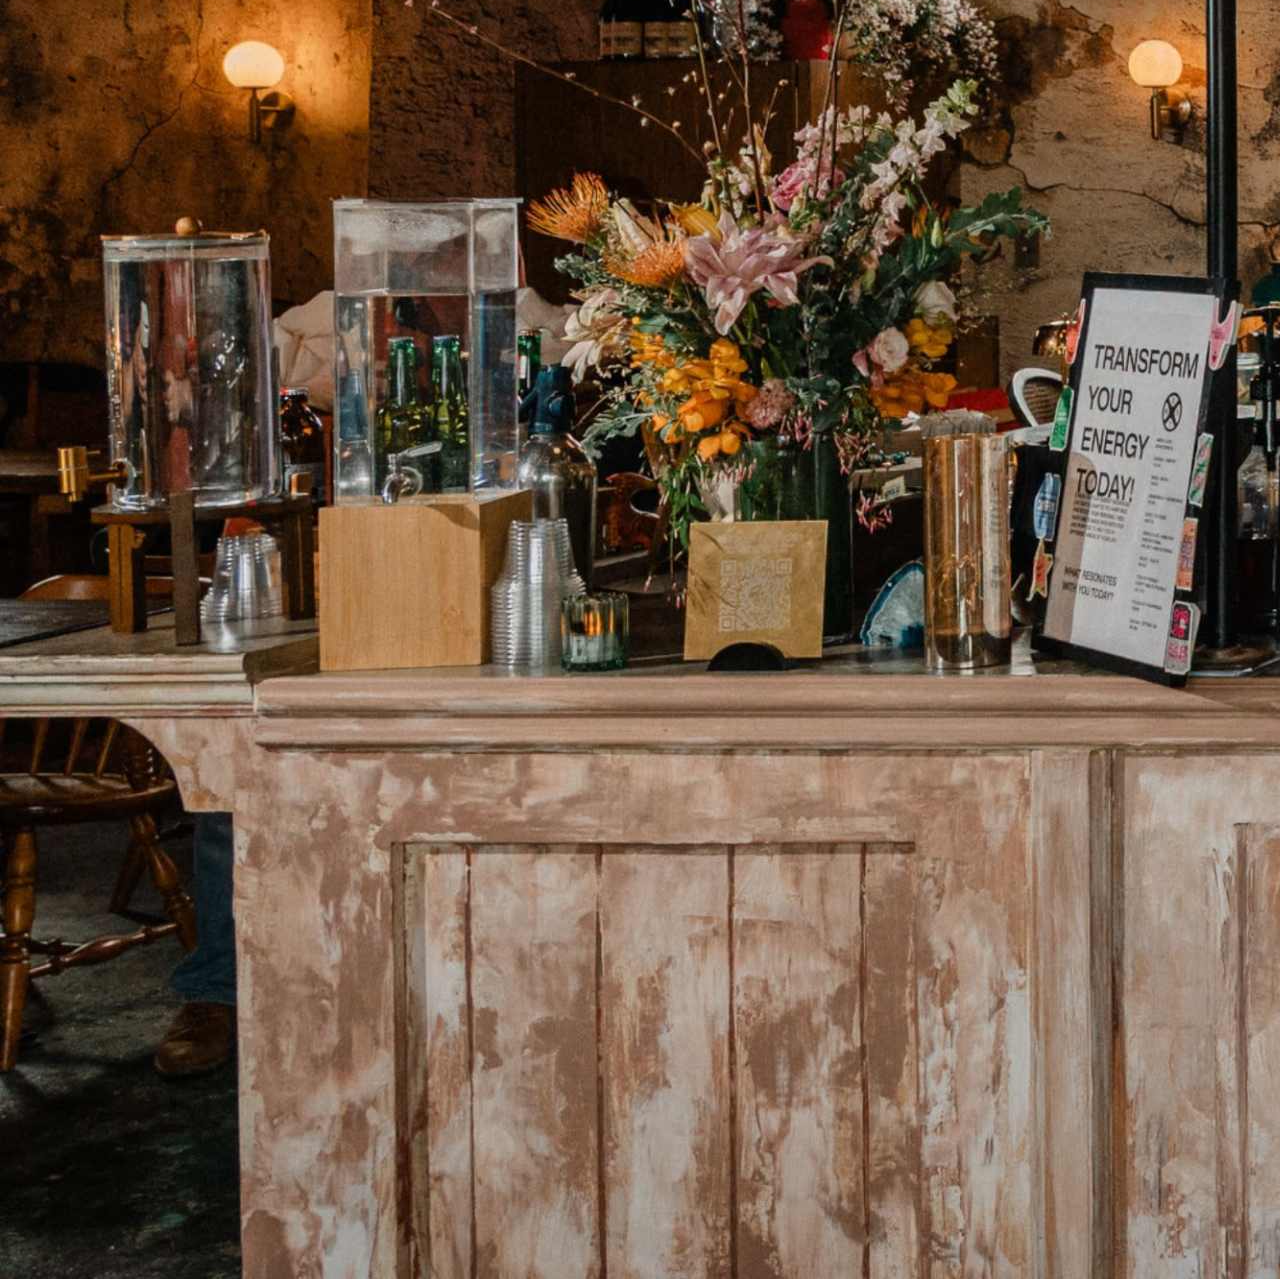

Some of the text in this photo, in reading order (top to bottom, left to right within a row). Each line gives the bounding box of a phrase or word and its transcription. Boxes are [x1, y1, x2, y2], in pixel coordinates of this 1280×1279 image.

[1093, 344, 1200, 380] TRANSFORM
[1088, 384, 1133, 415] YOUR
[1080, 426, 1150, 461] ENERGY
[1076, 467, 1136, 504] TODAY!
